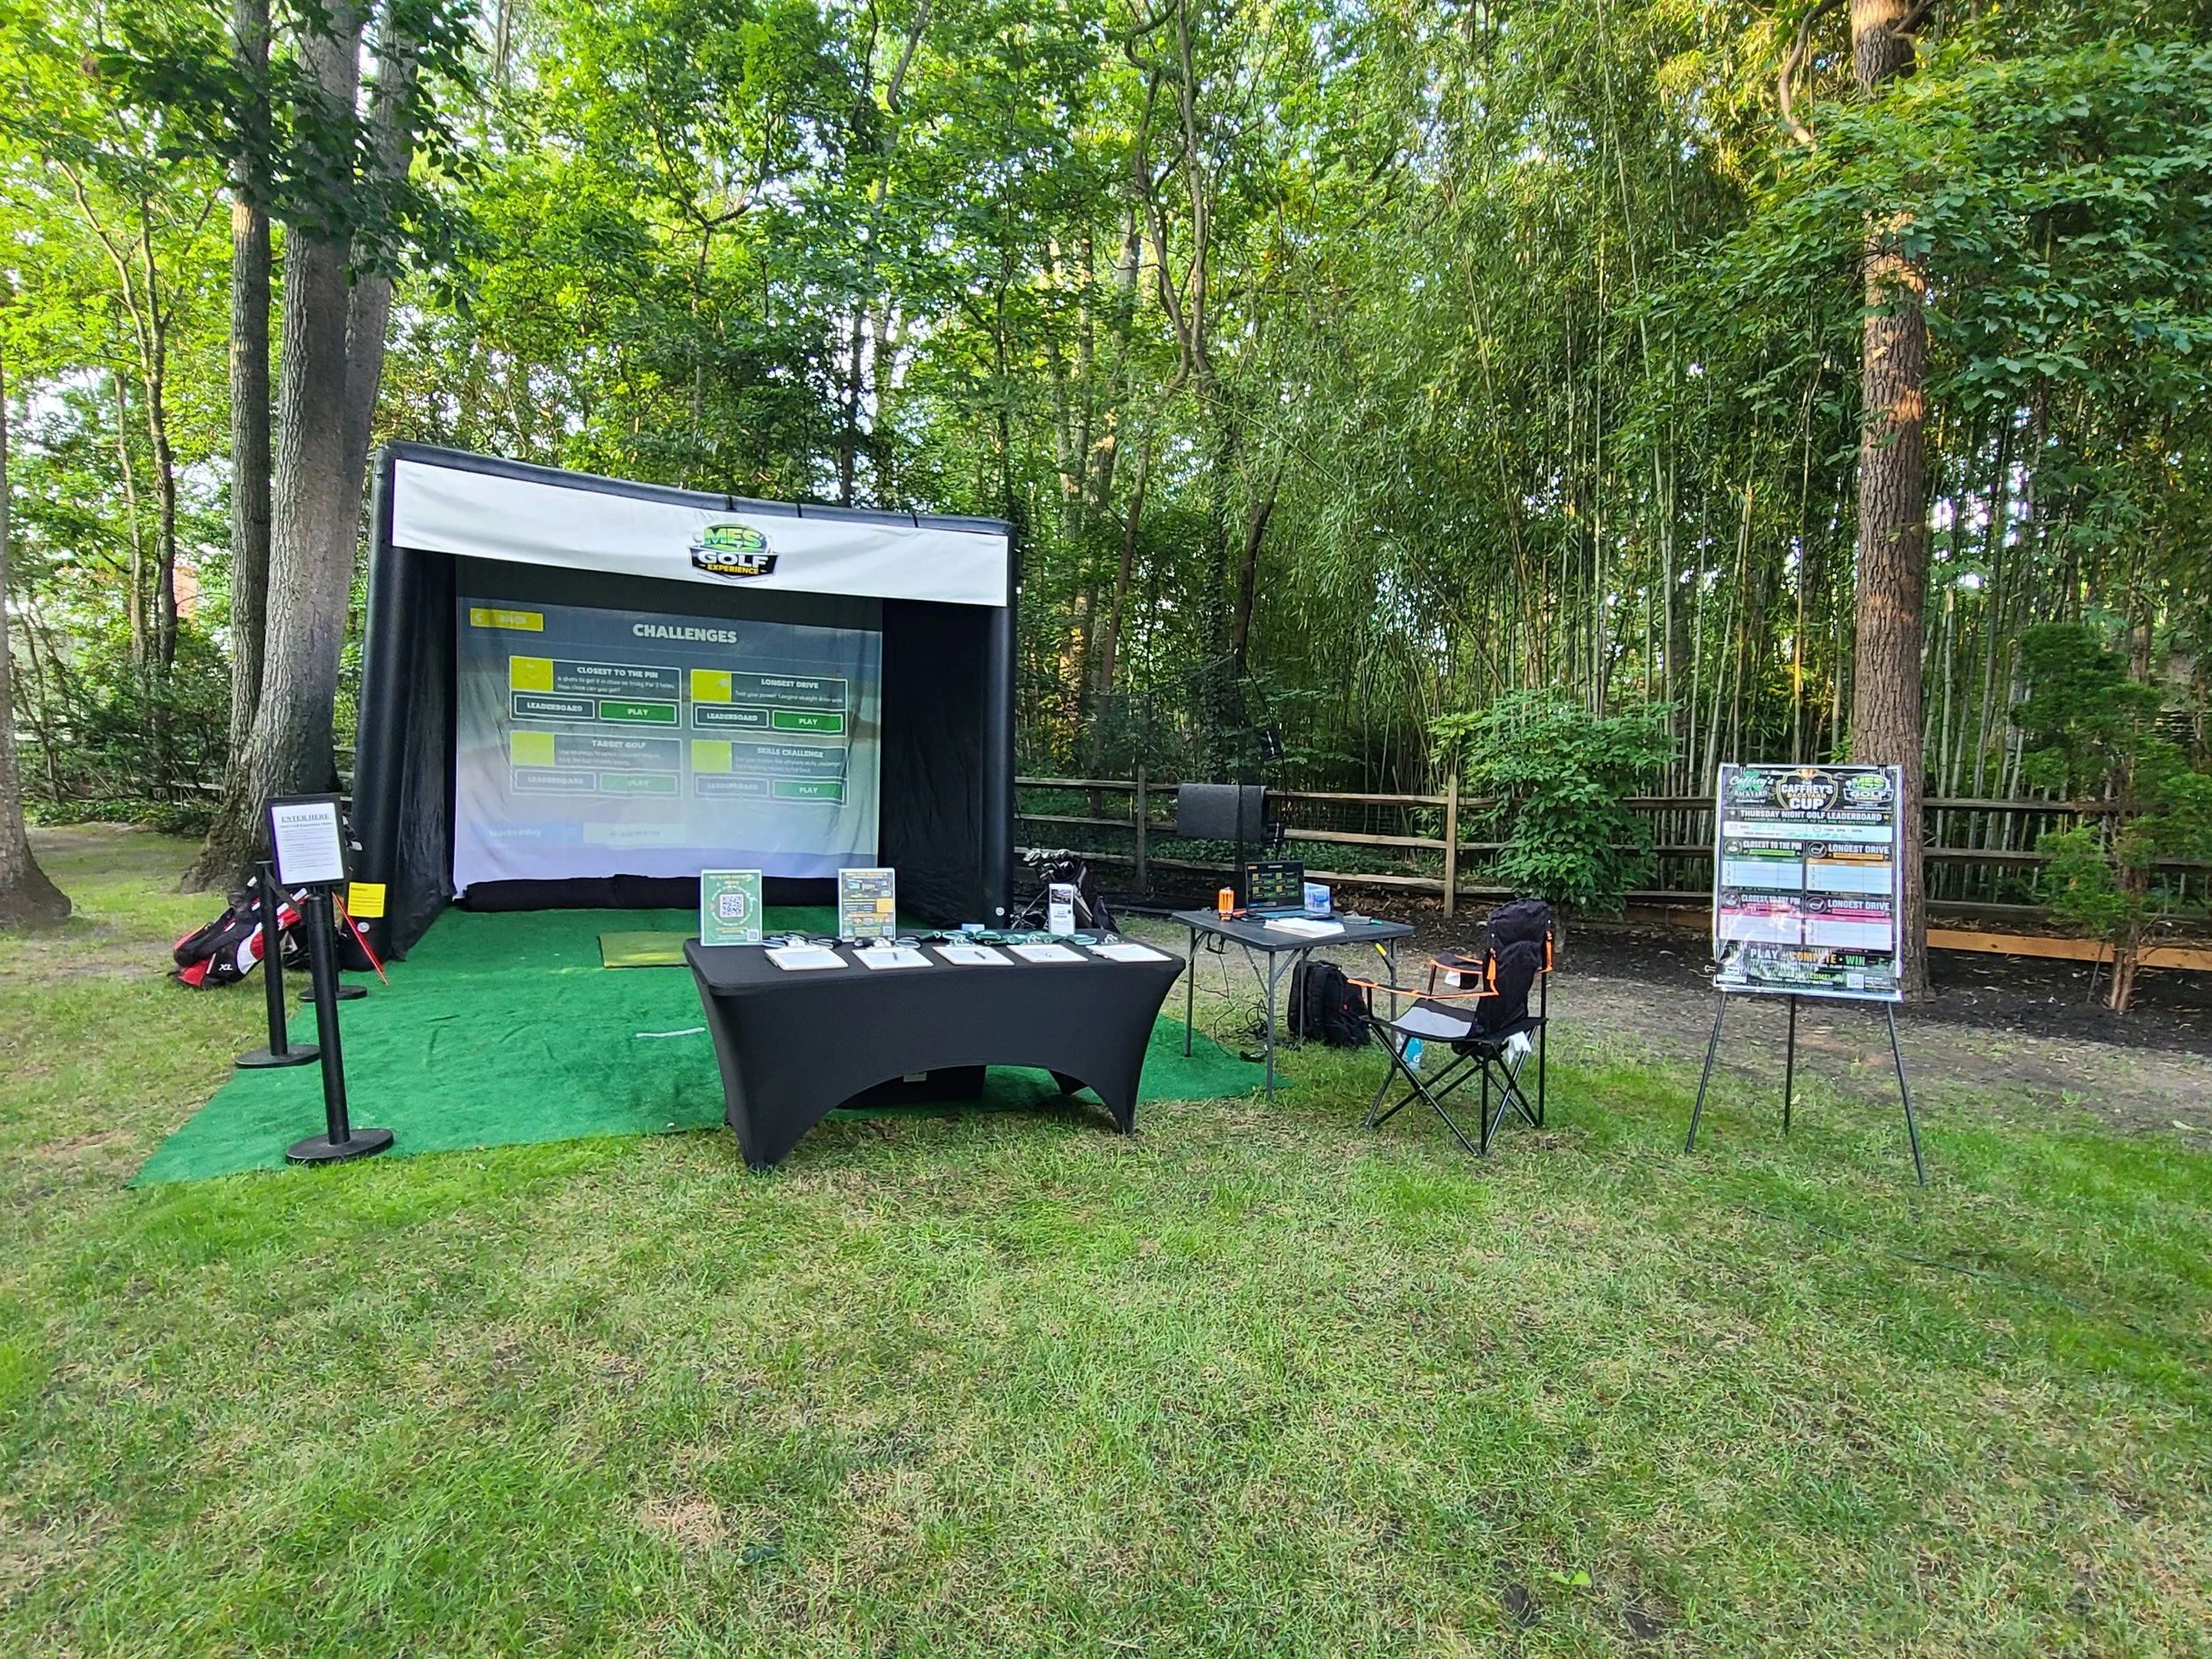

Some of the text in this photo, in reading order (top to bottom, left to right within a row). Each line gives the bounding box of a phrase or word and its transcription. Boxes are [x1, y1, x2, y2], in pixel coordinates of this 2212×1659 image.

[703, 527, 762, 548] MES
[697, 550, 768, 568] GOLF
[707, 564, 758, 574] EXPERIENCE
[633, 624, 738, 644] CHALLENGES
[577, 666, 611, 676] CLOSEST
[627, 670, 642, 679] THE
[761, 678, 819, 689] LONGEST DRIVE
[527, 702, 583, 712] LEADERBOARD
[706, 712, 758, 722] LEADERBOARD
[592, 740, 623, 749] TARGET
[757, 747, 824, 758] SKILLS CHALLENGE
[527, 776, 584, 785] LEADERBOARD
[1730, 776, 1775, 787] Caffrey's
[1852, 777, 1885, 788] MES
[1781, 784, 1833, 795] CAFFREY'S
[1789, 798, 1824, 810] CUP
[281, 814, 307, 823] ENTER
[1807, 810, 1825, 819] GOLF
[1827, 812, 1882, 821] LEADERBOARD
[1828, 843, 1890, 854] LONGEST DRIVE
[1741, 894, 1767, 902] CLOSEST
[1790, 896, 1801, 905] PIN
[1827, 899, 1890, 910] LONGEST DRIVE
[1750, 948, 1778, 959] PLAY
[1845, 955, 1865, 965] WIN
